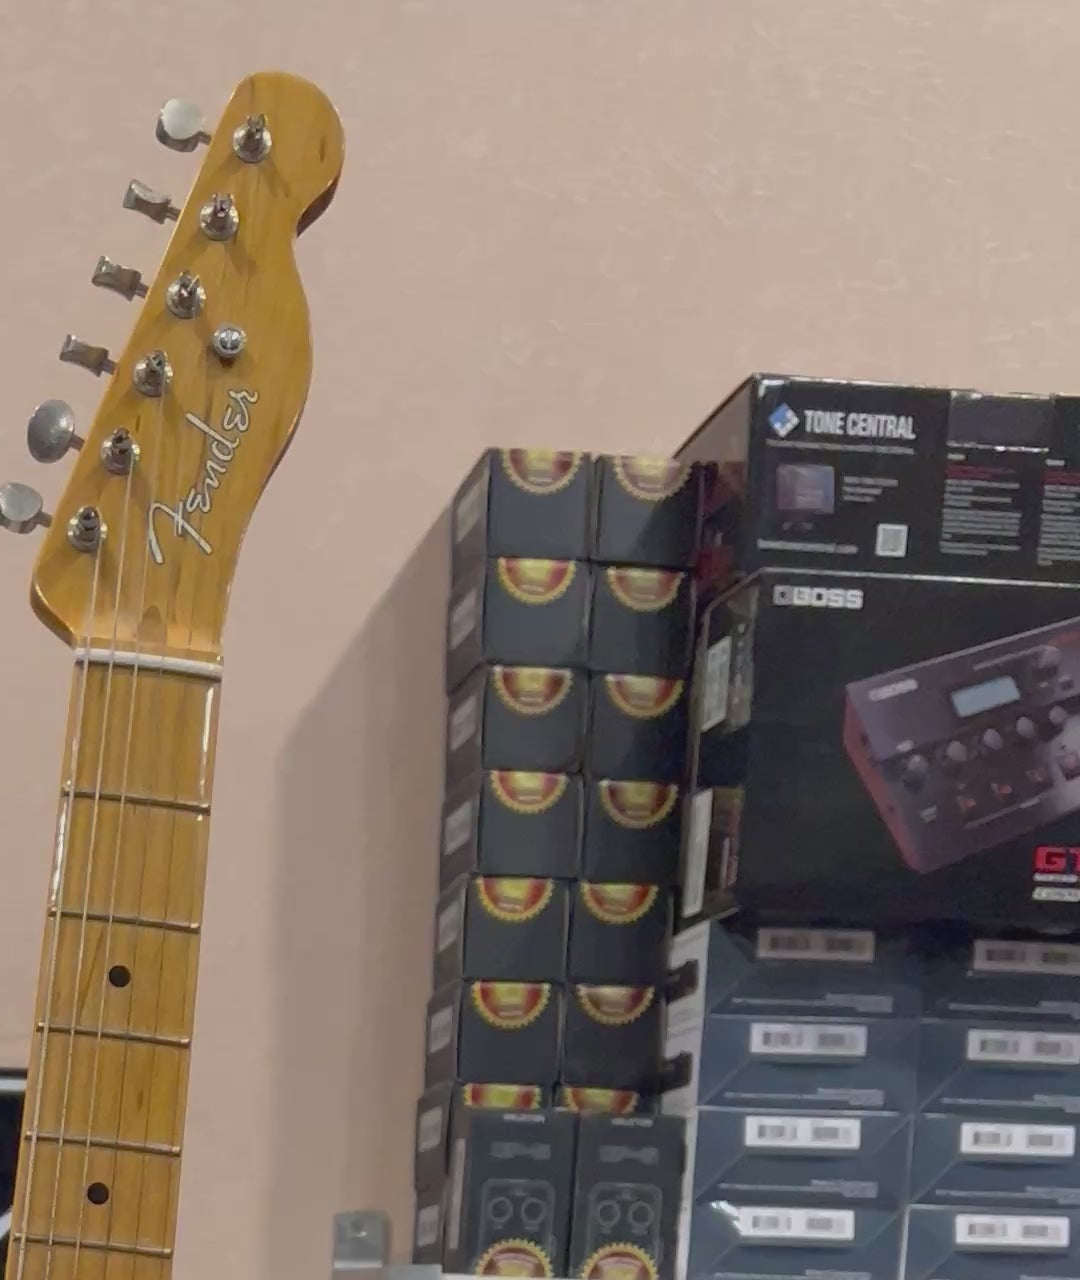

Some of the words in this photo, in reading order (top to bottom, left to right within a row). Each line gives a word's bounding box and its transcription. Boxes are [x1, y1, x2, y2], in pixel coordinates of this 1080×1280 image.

[804, 409, 845, 434] TONE
[846, 413, 916, 440] CENTRAL
[148, 389, 259, 564] Fender
[791, 586, 864, 609] BOSS
